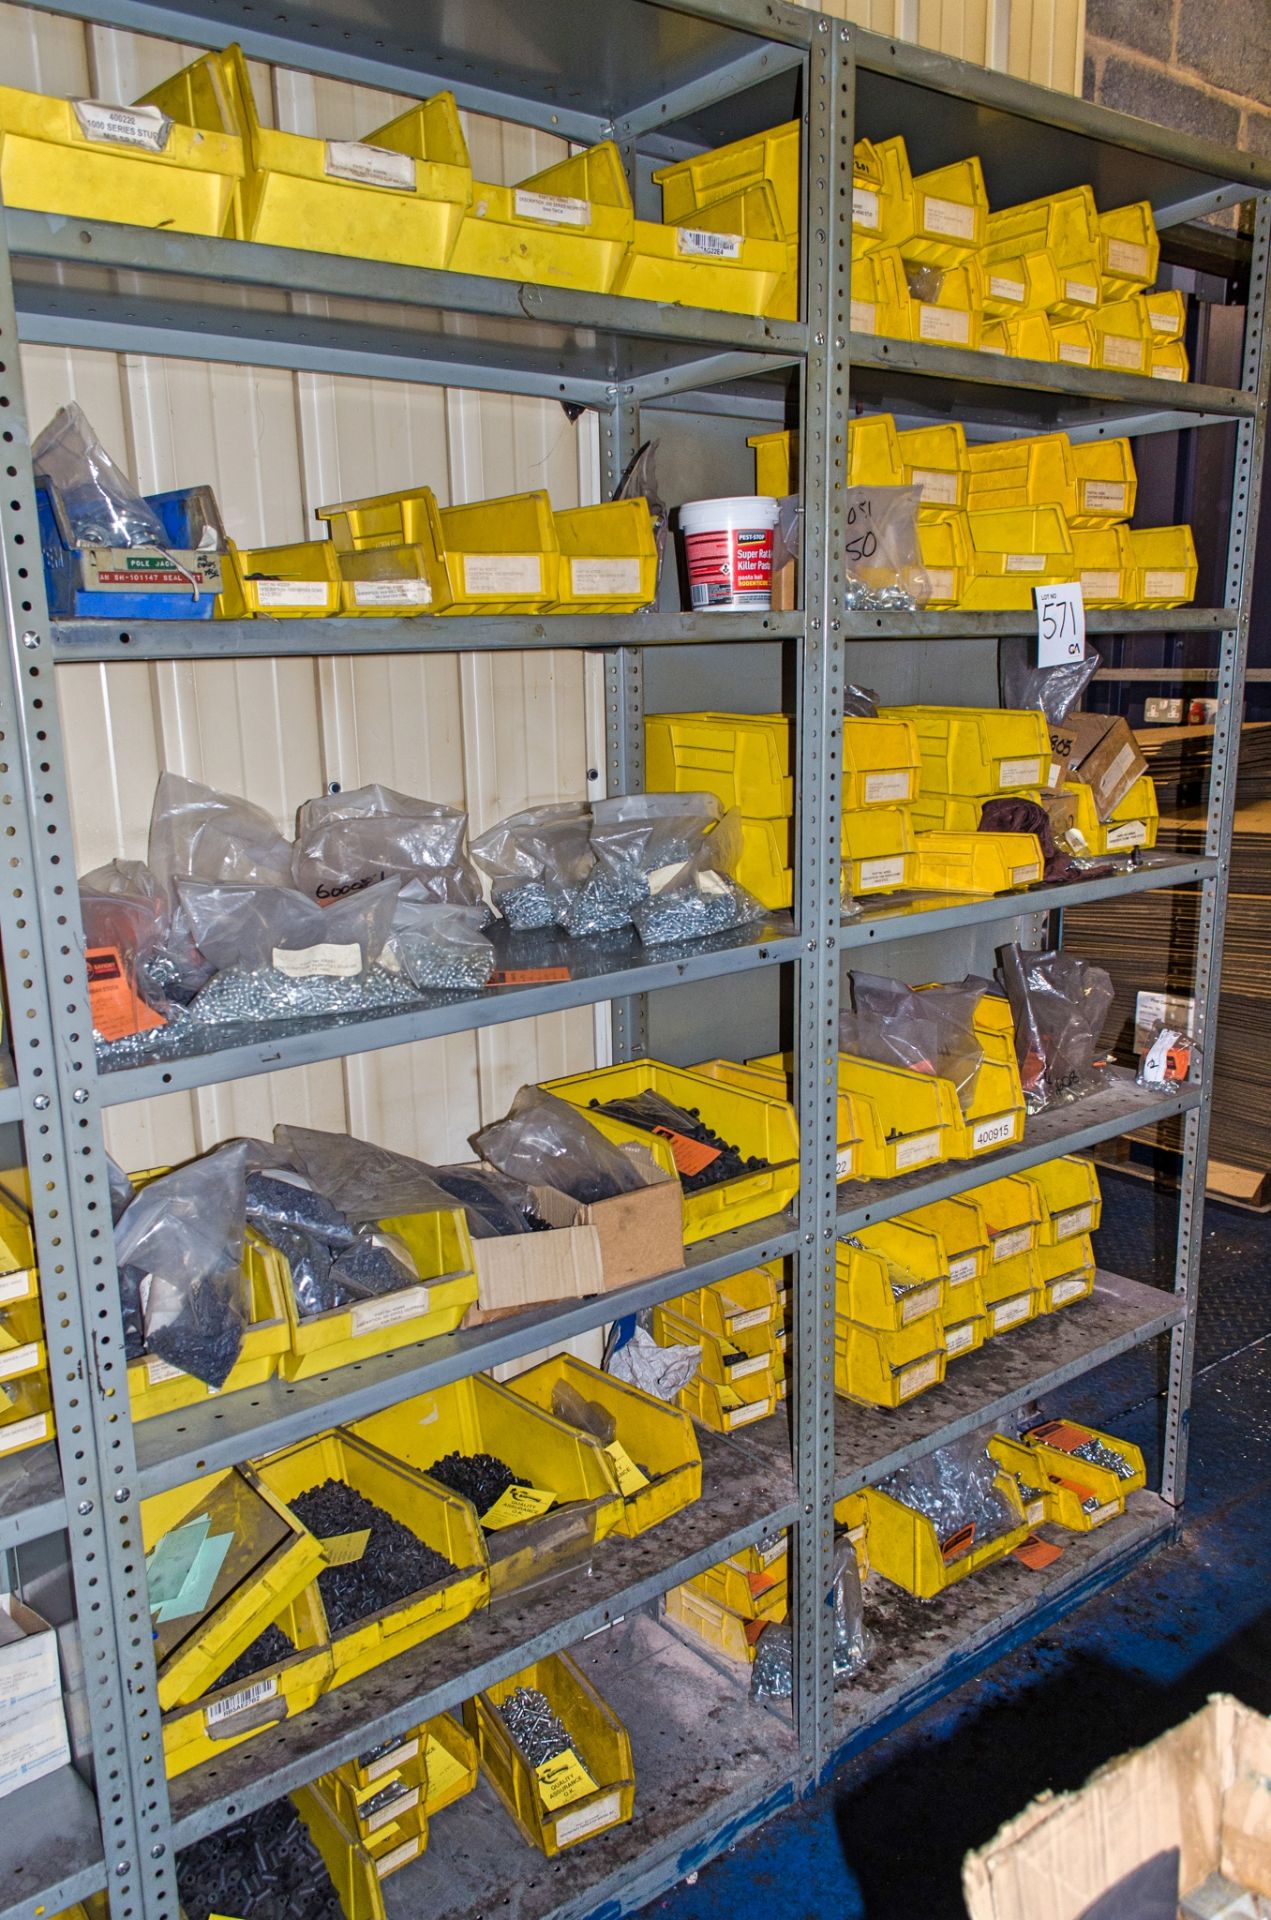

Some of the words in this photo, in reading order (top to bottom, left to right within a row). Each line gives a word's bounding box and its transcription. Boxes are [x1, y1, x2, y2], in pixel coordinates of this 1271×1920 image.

[87, 119, 105, 130] 1000
[106, 123, 136, 136] SERIES
[130, 559, 150, 567] POLE
[737, 549, 758, 560] Super
[737, 561, 758, 570] Killer
[1043, 602, 1076, 640] 571
[977, 1124, 1009, 1144] 400915
[549, 1775, 582, 1799] ASSURANCE
[550, 1774, 575, 1791] QUALITY
